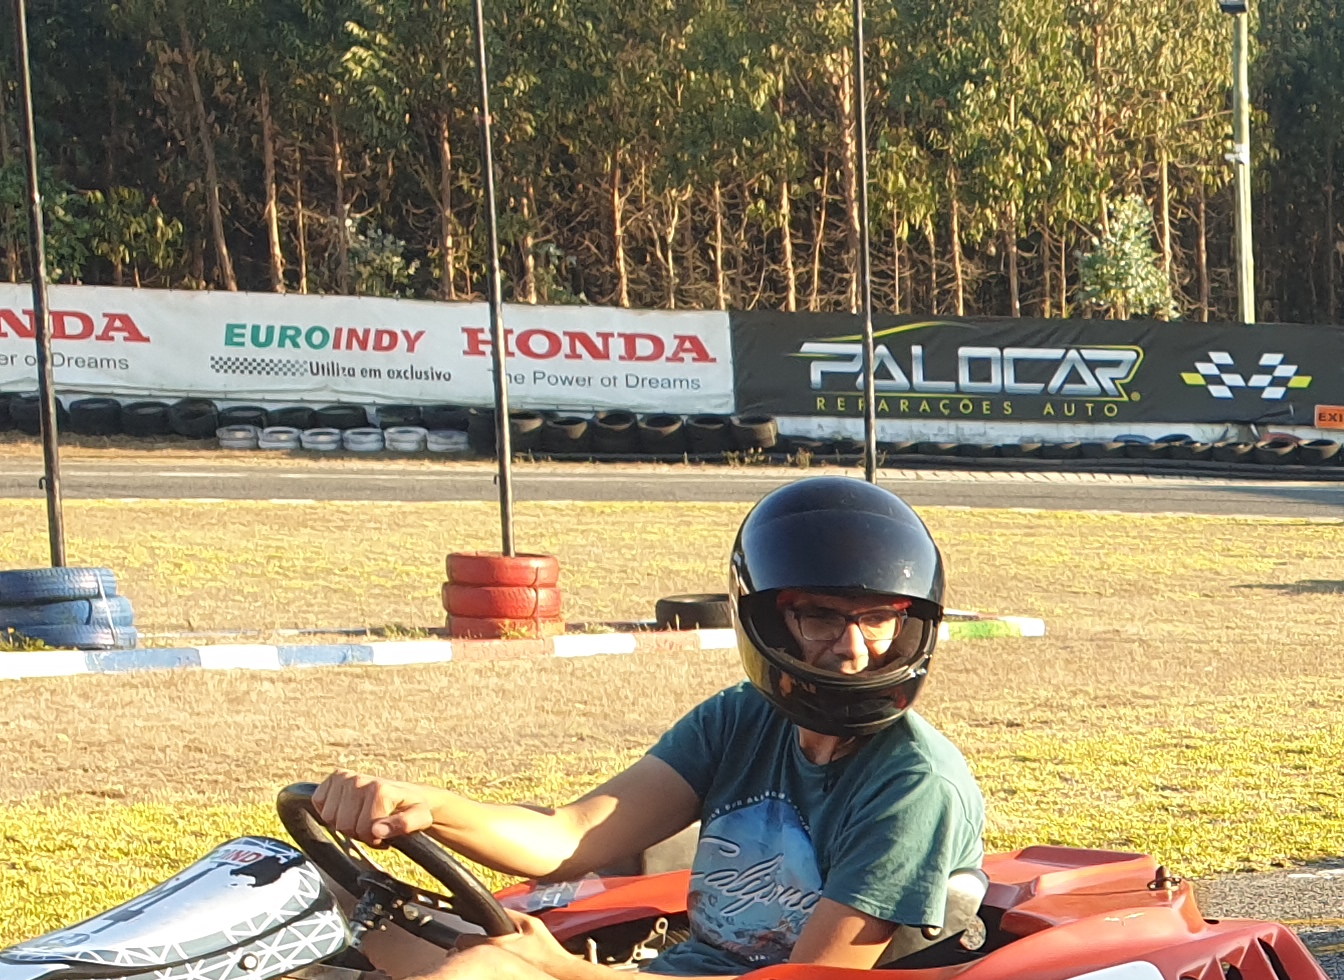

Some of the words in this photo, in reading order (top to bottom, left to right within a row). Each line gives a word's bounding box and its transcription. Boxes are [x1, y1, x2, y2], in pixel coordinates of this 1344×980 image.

[224, 323, 426, 353] EUROINDY
[461, 326, 717, 363] HONDA
[50, 352, 129, 371] Dreams
[308, 360, 356, 378] Utiliza
[361, 366, 382, 379] em
[387, 365, 452, 382] exclusivo
[800, 341, 1141, 397] PALOCAR
[533, 371, 593, 387] Power
[601, 373, 619, 388] of
[626, 374, 700, 390] Dreams
[1043, 400, 1118, 417] AUTO
